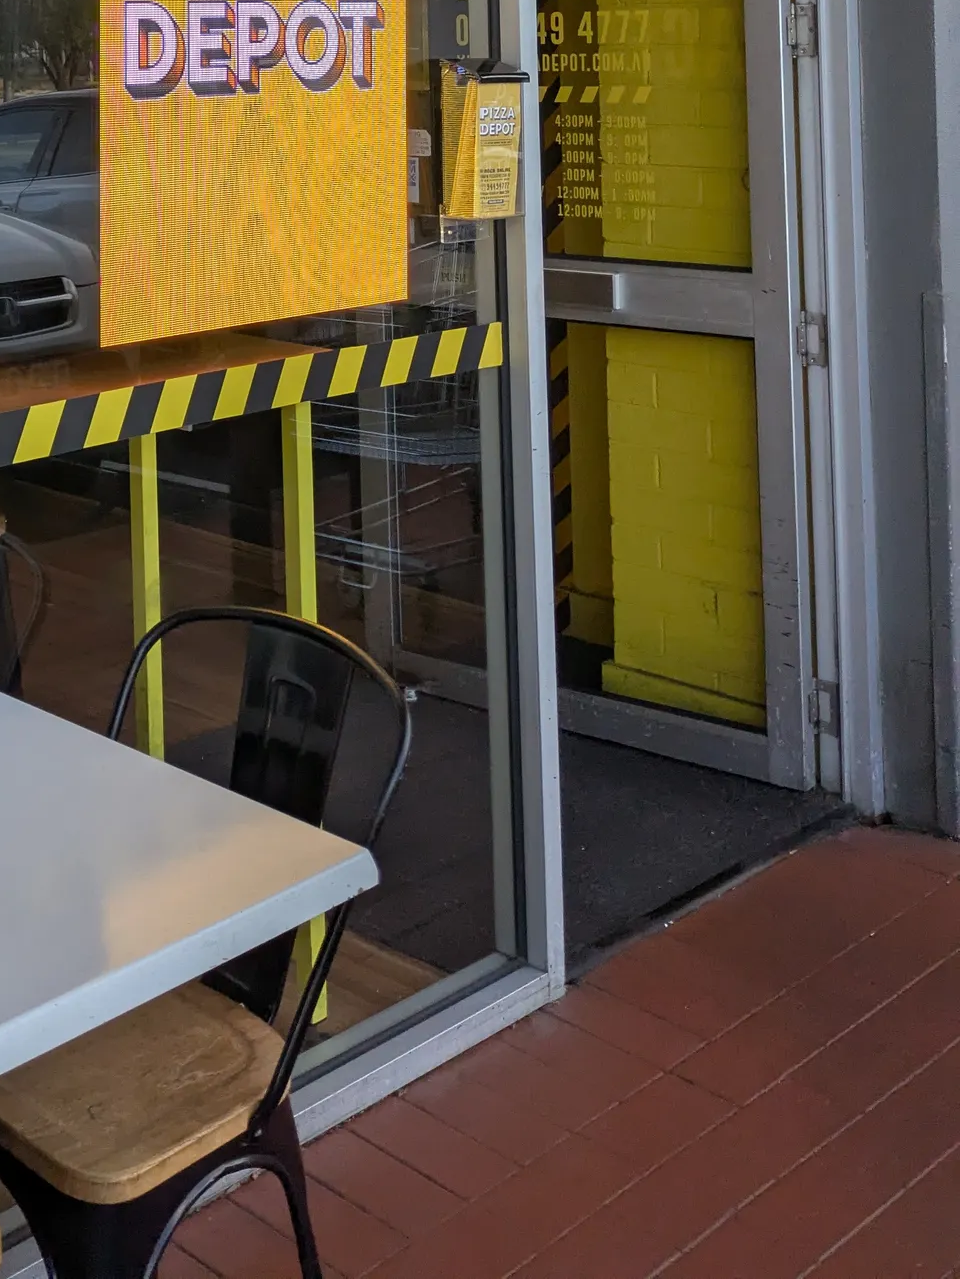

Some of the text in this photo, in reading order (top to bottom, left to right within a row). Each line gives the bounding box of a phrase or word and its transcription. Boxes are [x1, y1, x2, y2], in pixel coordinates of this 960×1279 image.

[577, 9, 650, 44] 4777
[480, 106, 516, 121] PIZZA
[554, 114, 594, 128] 4:30PM
[480, 122, 515, 136] DEPOT
[555, 132, 594, 146] 4:30PM
[556, 185, 600, 200] 12:00PM
[557, 203, 603, 219] 12:00PM
